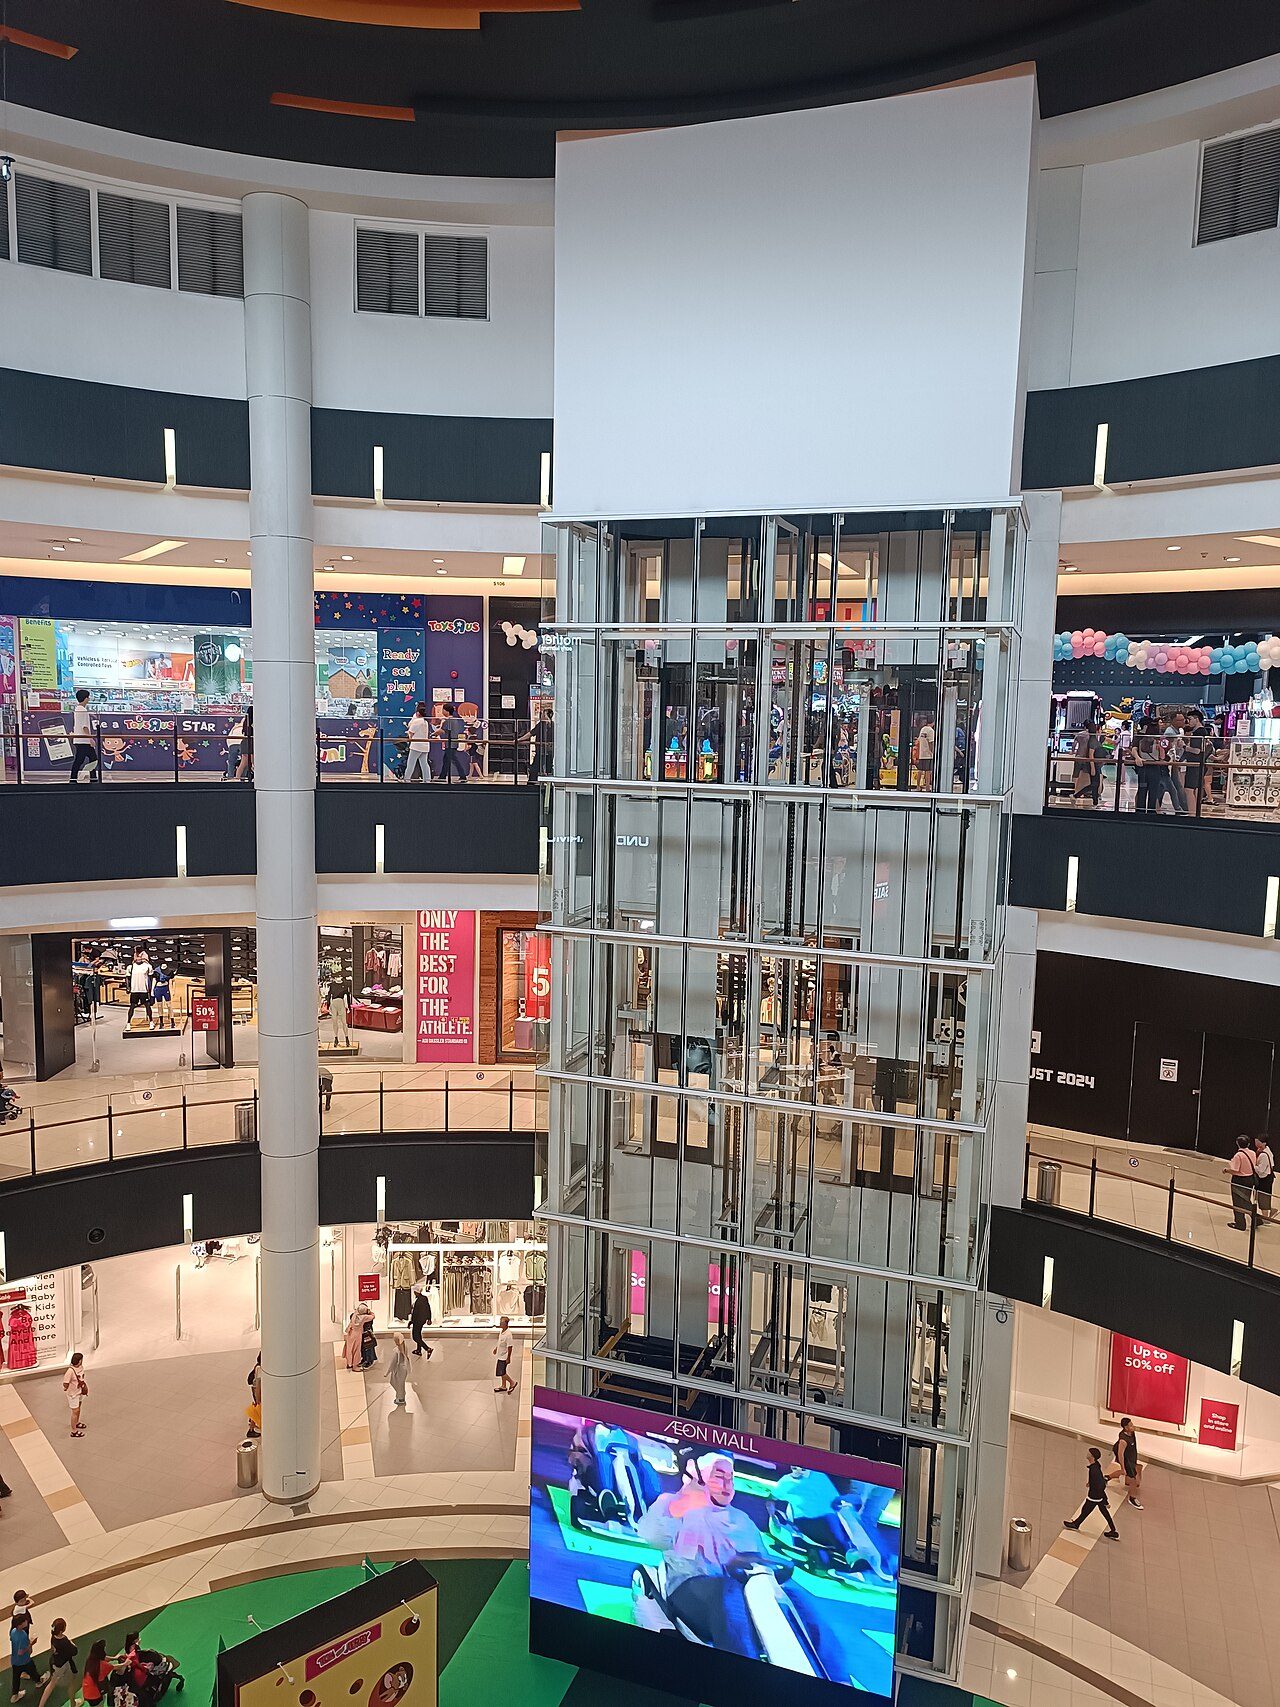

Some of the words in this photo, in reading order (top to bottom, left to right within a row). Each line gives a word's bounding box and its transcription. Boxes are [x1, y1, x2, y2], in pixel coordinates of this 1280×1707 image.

[383, 649, 420, 663] Ready
[392, 666, 411, 677] set
[387, 681, 416, 694] play!
[112, 720, 120, 729] a
[183, 720, 216, 732] STAR
[419, 910, 459, 929] ONLY
[419, 932, 450, 951] THE
[419, 954, 458, 973] BEST
[419, 976, 449, 995] FOR
[195, 1007, 215, 1016] 50%
[419, 998, 449, 1017] THE
[418, 1019, 473, 1035] ATHLETE.
[1057, 1071, 1095, 1089] 2024
[18, 1282, 55, 1292] Divided
[31, 1293, 56, 1302] Baby
[35, 1303, 56, 1311] Kids
[38, 1323, 56, 1331] Box
[33, 1333, 57, 1342] more
[1133, 1344, 1151, 1359] Up
[1153, 1349, 1168, 1360] to
[1124, 1356, 1152, 1371] 50%
[1154, 1363, 1175, 1375] off
[711, 1428, 759, 1454] MALL
